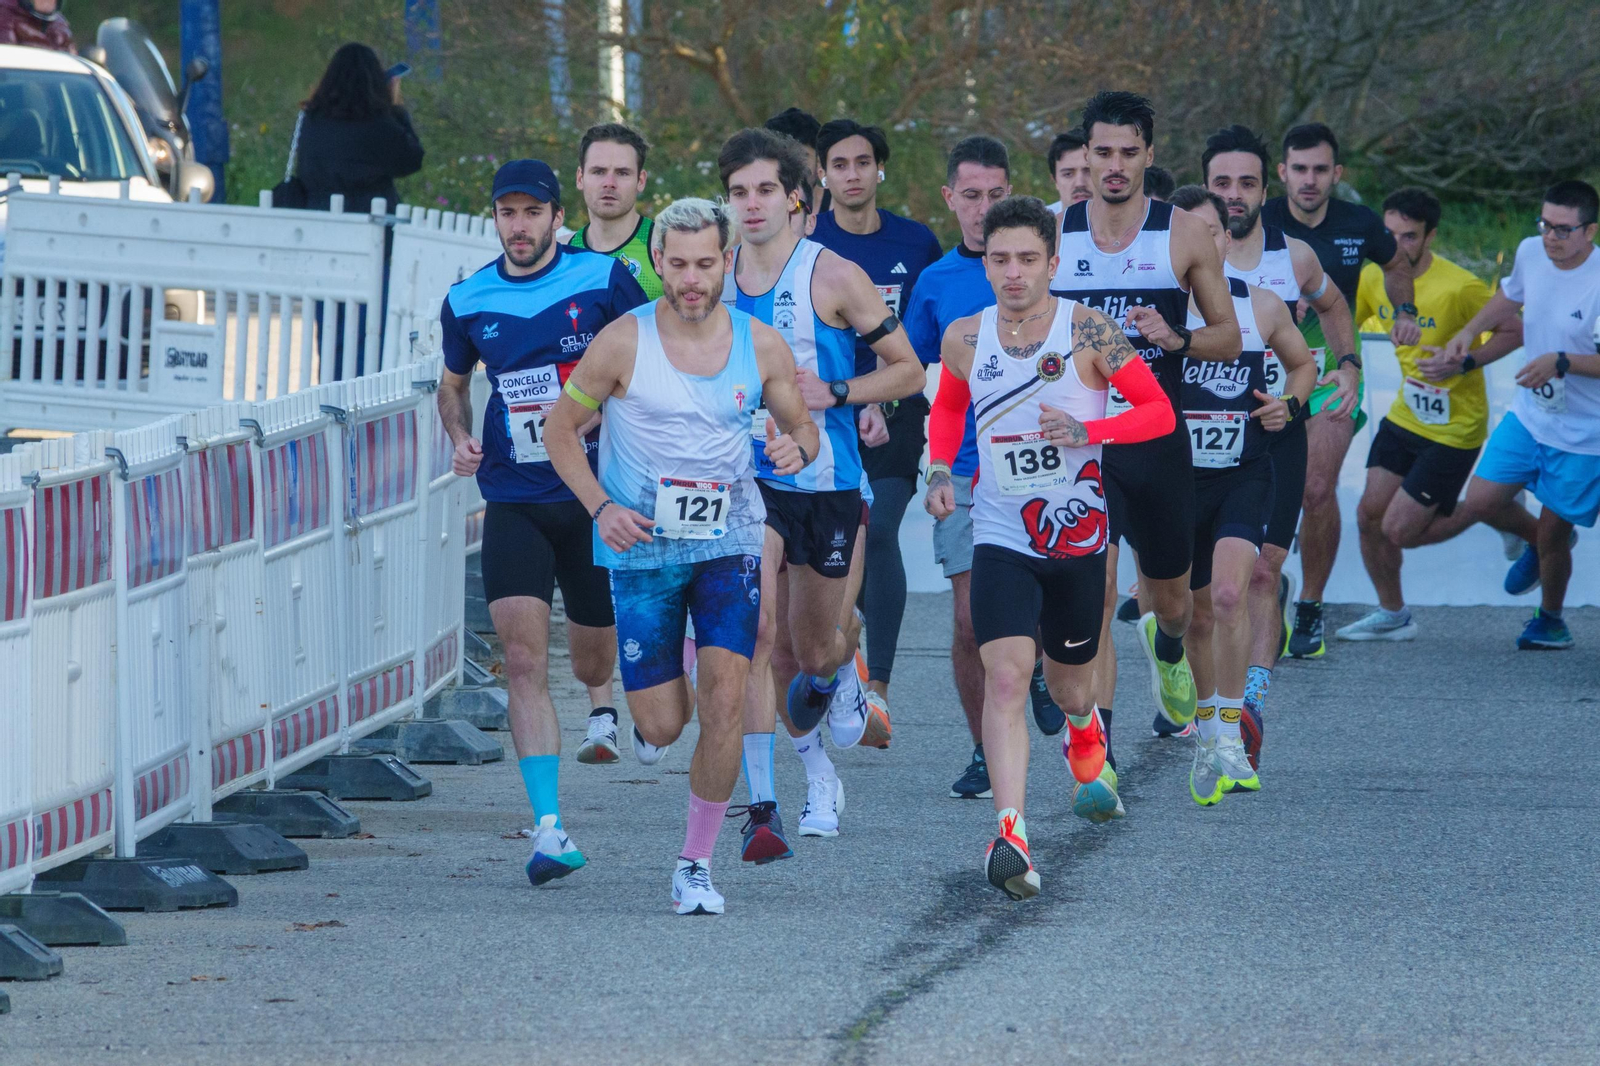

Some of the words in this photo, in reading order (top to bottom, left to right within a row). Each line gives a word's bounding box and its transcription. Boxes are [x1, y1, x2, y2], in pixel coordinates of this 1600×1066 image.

[482, 331, 499, 340] ZICO
[560, 332, 594, 348] CELTA
[502, 372, 552, 389] CONCELLO
[1215, 382, 1236, 392] fresh
[507, 389, 519, 400] DE
[520, 385, 549, 397] VIGO
[1413, 393, 1445, 415] 114
[1191, 427, 1240, 450] 127
[1004, 445, 1061, 476] 138
[675, 496, 723, 521] 121
